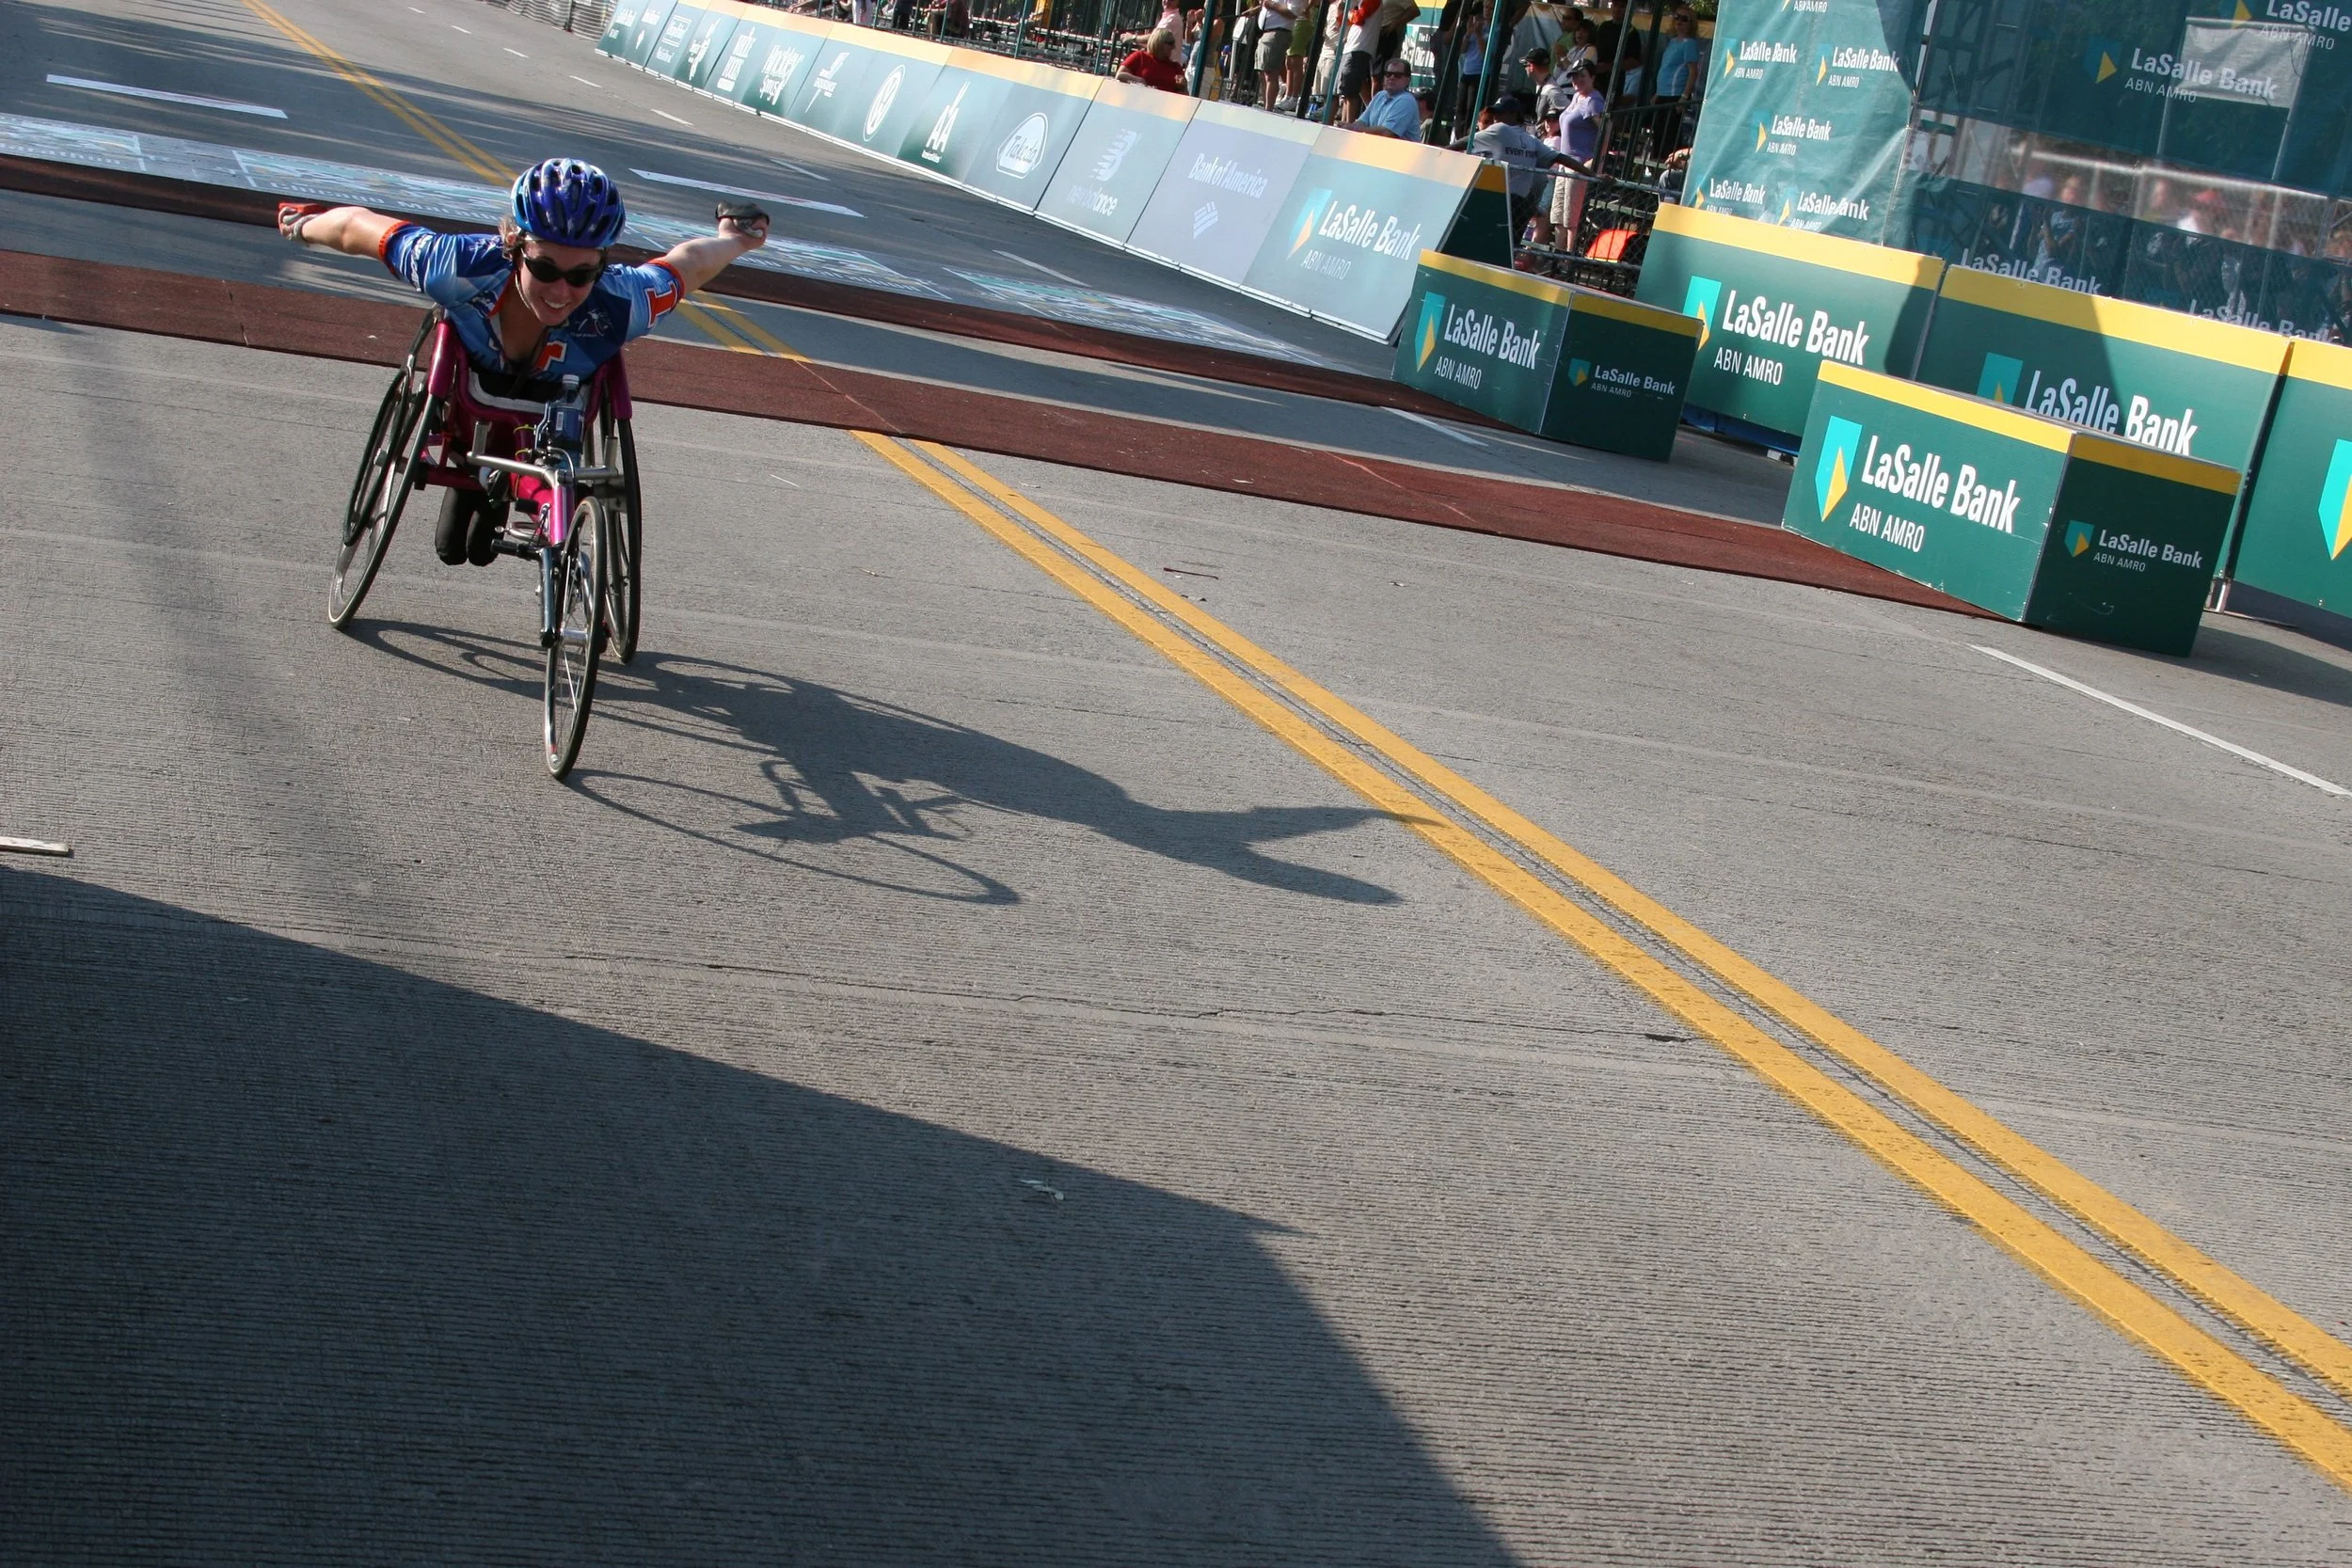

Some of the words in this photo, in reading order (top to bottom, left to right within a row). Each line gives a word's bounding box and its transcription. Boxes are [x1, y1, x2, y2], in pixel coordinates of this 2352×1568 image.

[2265, 0, 2351, 32] LaSalle
[1740, 40, 1771, 62] LaSalle
[1772, 42, 1798, 64] Bank
[2293, 31, 2335, 50] AMRO
[1745, 68, 1764, 80] AMRO
[1832, 46, 1868, 70] LaSalle
[1869, 49, 1900, 72] Bank
[2130, 47, 2214, 86] LaSalle
[2218, 67, 2280, 101] Bank
[1827, 74, 1841, 87] ABN
[1841, 75, 1860, 88] AMRO
[2124, 77, 2153, 93] ABN
[2155, 84, 2197, 103] AMRO
[1771, 114, 1805, 138] LaSalle
[1806, 119, 1832, 141] Bank
[1767, 141, 1779, 153] ABN
[1187, 152, 1219, 184] Bank
[1211, 159, 1233, 187] of
[1220, 161, 1268, 198] America
[1708, 178, 1742, 201] LaSalle
[1742, 182, 1767, 205] Bank
[1797, 191, 1836, 215] LaSalle
[1318, 200, 1378, 248] LaSalle
[1373, 215, 1422, 261] Bank
[1300, 248, 1326, 272] ABN
[1319, 254, 1352, 280] AMRO
[1444, 304, 1499, 356] LaSalle
[1498, 321, 1541, 371] Bank
[1722, 290, 1804, 348] LaSalle
[1805, 309, 1869, 366] Bank
[1434, 356, 1456, 380] ABN
[1454, 362, 1483, 389] AMRO
[1595, 365, 1641, 387] LaSalle
[1644, 376, 1676, 395] Bank
[1713, 346, 1742, 374] ABN
[1742, 355, 1784, 386] AMRO
[1591, 382, 1608, 392] ABN
[1609, 387, 1632, 398] AMRO
[2025, 370, 2120, 435] LaSalle
[2124, 394, 2199, 456] Bank
[1861, 435, 1949, 509] LaSalle
[1949, 464, 2021, 534] Bank
[1849, 502, 1882, 537] ABN
[1881, 514, 1926, 553] AMRO
[2092, 552, 2116, 565] ABN
[2116, 558, 2146, 573] AMRO
[2098, 529, 2158, 559] LaSalle
[2161, 544, 2203, 569] Bank
